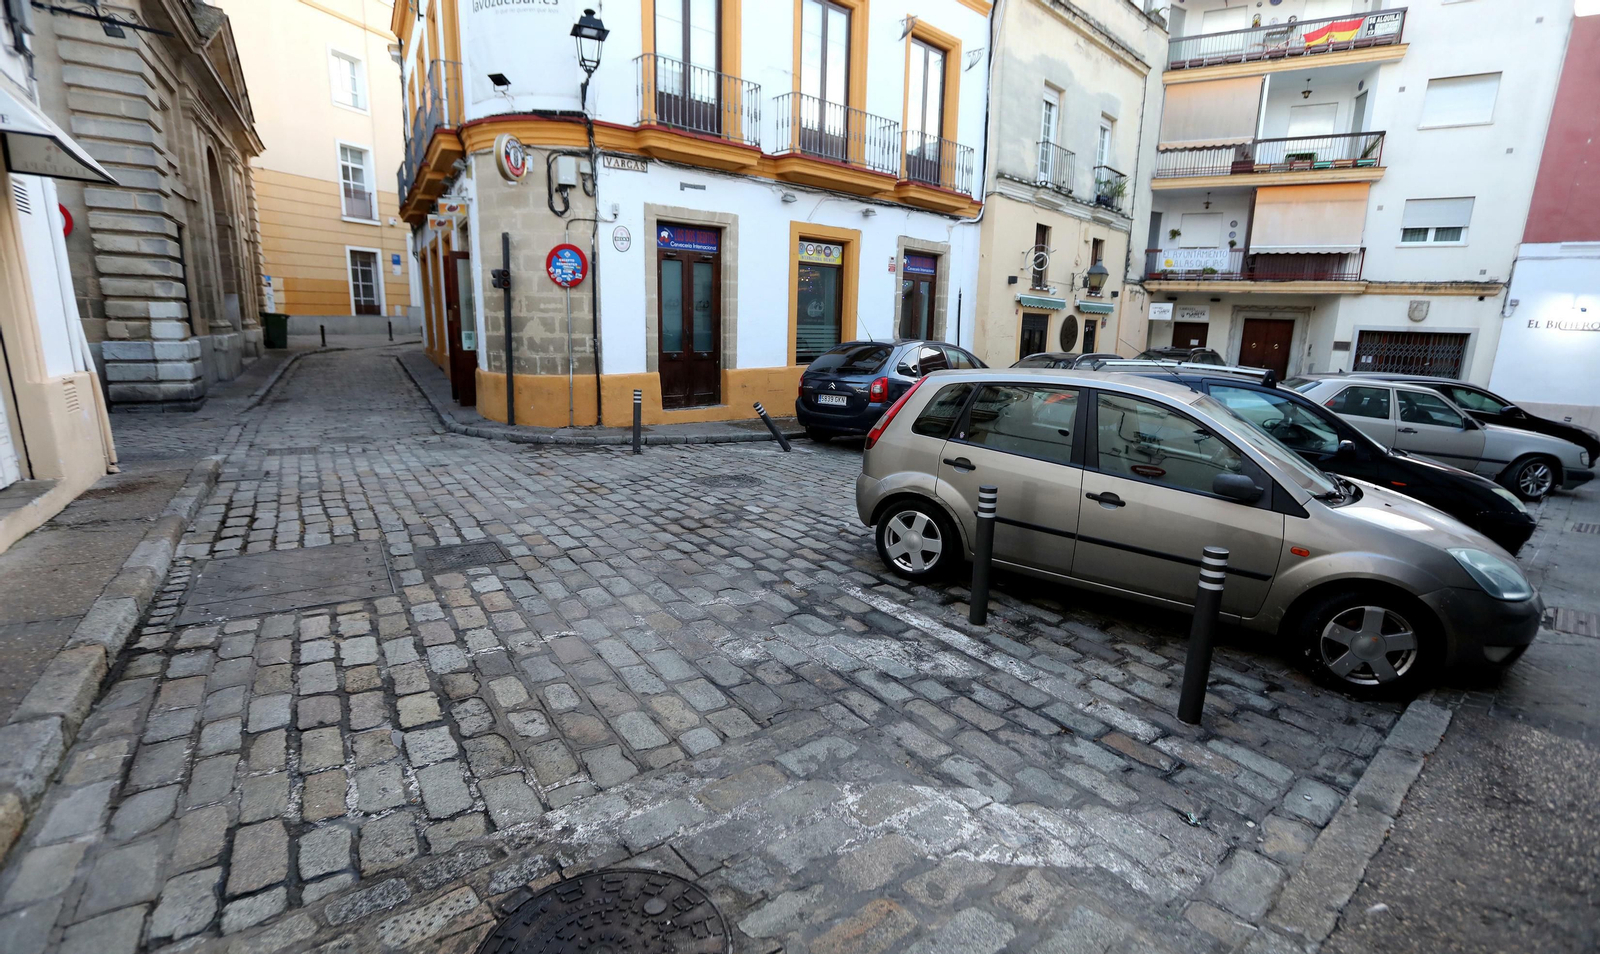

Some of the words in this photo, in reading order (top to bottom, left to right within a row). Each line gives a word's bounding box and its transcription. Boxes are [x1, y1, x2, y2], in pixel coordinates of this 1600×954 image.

[1377, 13, 1399, 22] ALQUILA
[605, 157, 646, 170] VARGAS
[1527, 319, 1540, 329] EL
